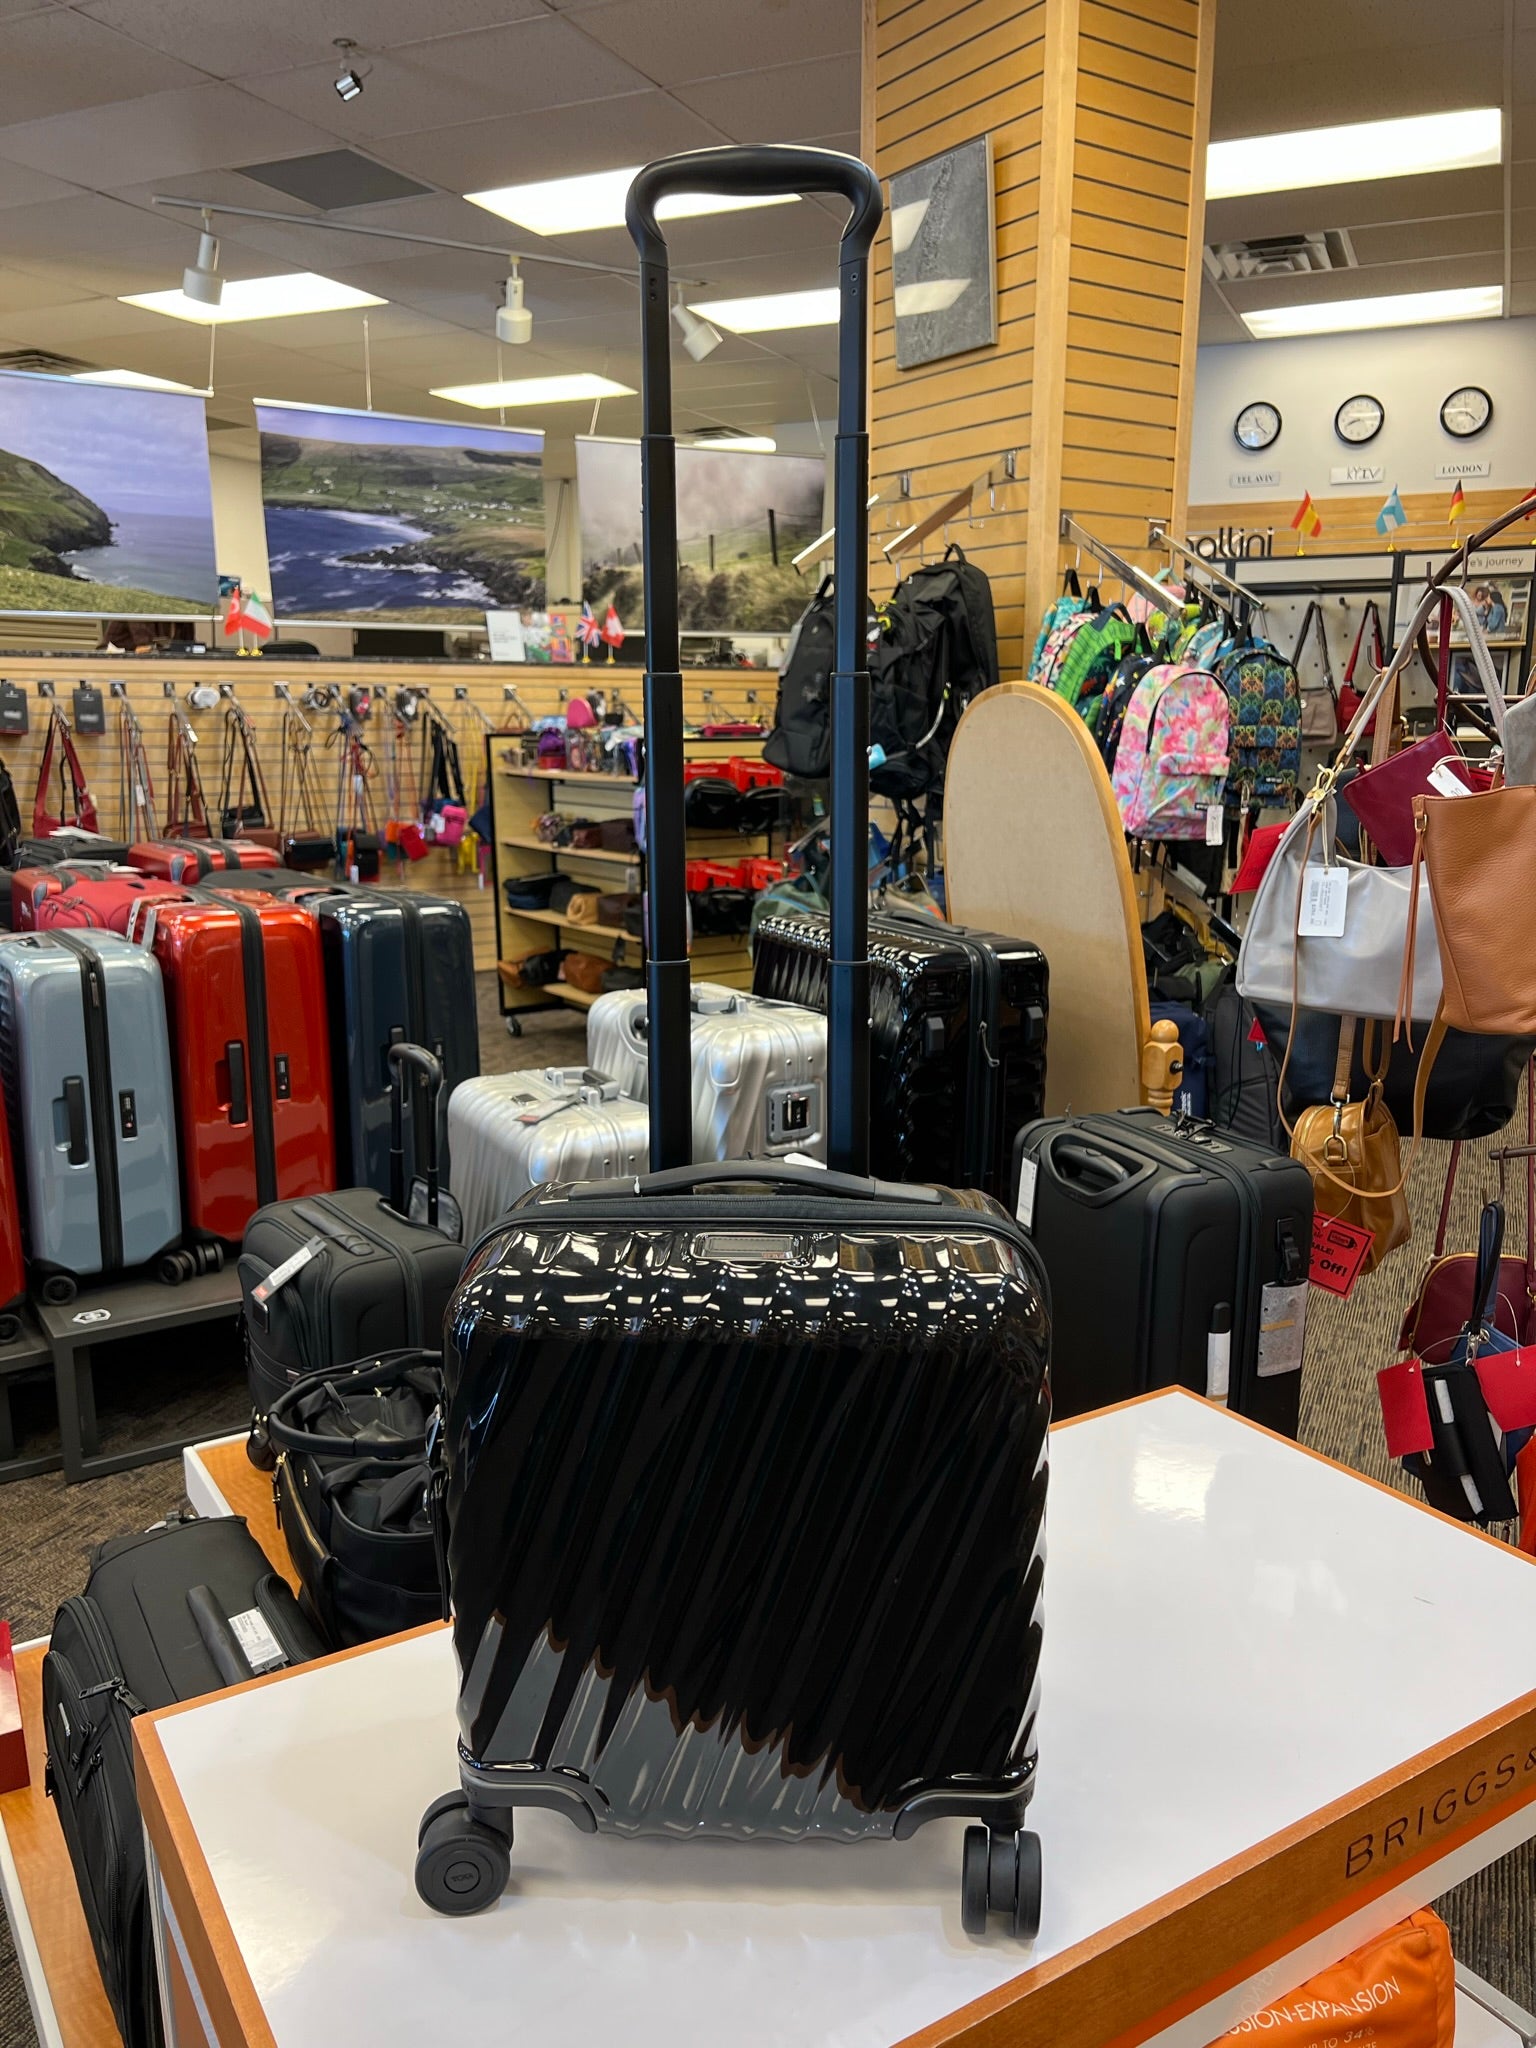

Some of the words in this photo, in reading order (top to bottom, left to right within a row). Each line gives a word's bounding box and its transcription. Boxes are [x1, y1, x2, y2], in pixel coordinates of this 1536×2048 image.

[1441, 463, 1484, 475] LONDON
[1485, 556, 1524, 569] journey
[1319, 1259, 1348, 1277] Off!
